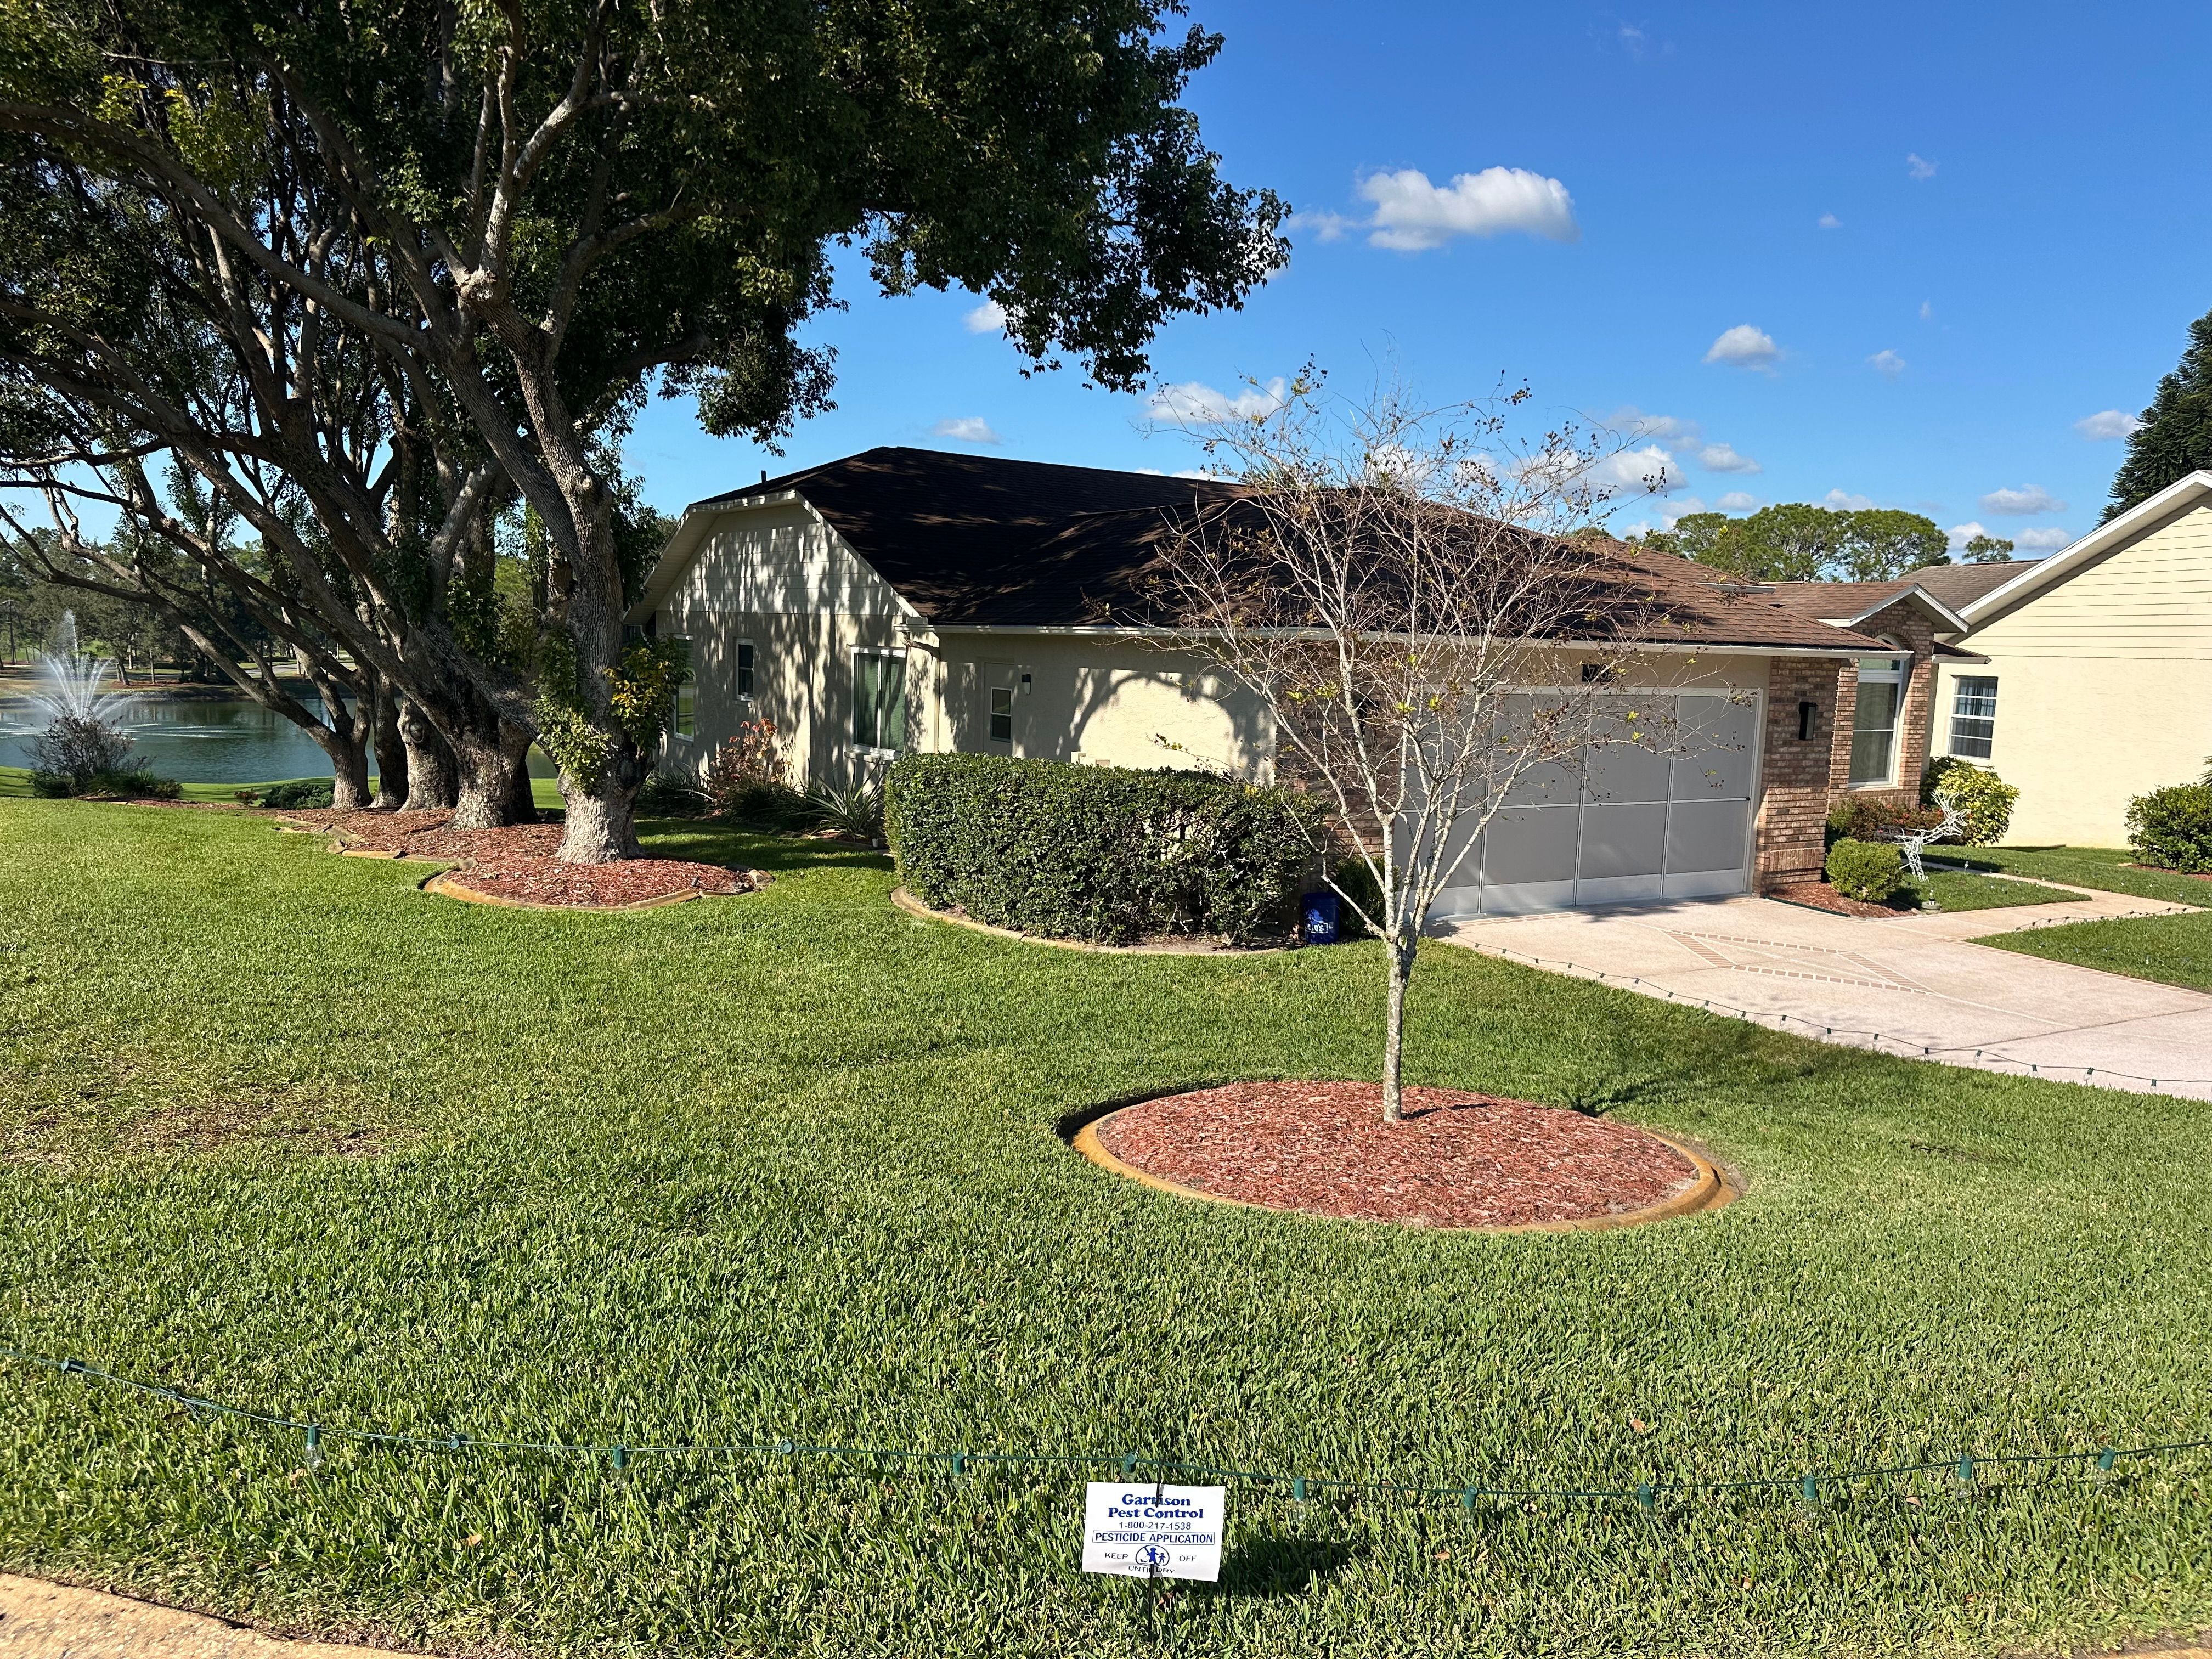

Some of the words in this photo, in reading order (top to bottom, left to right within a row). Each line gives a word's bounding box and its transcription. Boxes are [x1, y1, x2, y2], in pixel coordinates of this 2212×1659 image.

[1122, 1493, 1191, 1506] Garrison
[1108, 1507, 1141, 1518] Pest
[1144, 1508, 1204, 1519] Control
[1119, 1521, 1192, 1530] 1-800-217-1538
[1095, 1532, 1146, 1542] PESTICIDE
[1149, 1533, 1213, 1543] APPLICATION
